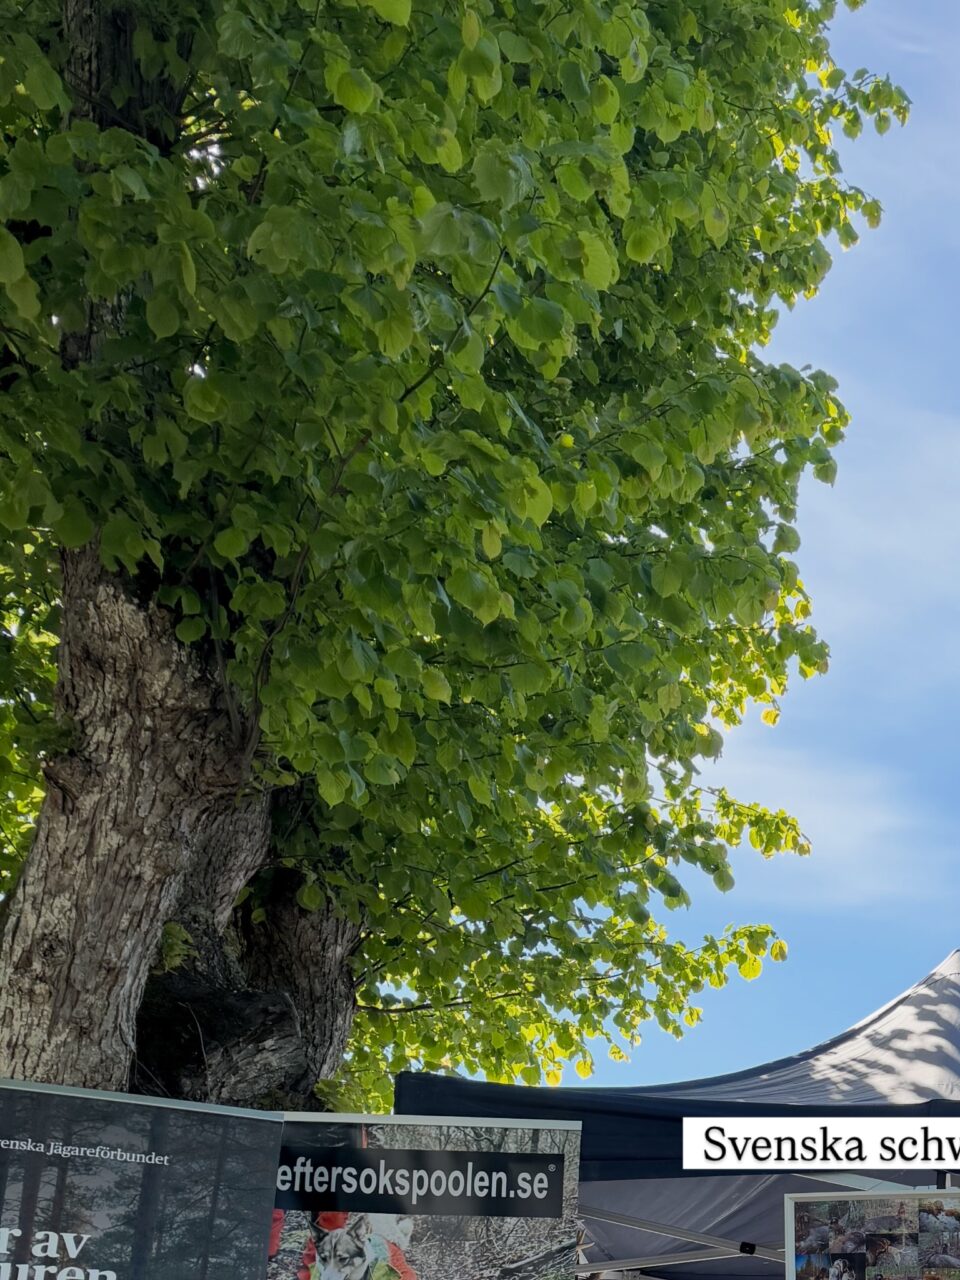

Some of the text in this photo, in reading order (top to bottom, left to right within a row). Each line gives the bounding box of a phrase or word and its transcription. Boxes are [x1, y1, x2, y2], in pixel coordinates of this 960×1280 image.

[0, 1138, 170, 1166] enska Jägareförbundet
[275, 1156, 549, 1205] eftersokspoolen.se
[31, 1230, 92, 1259] av
